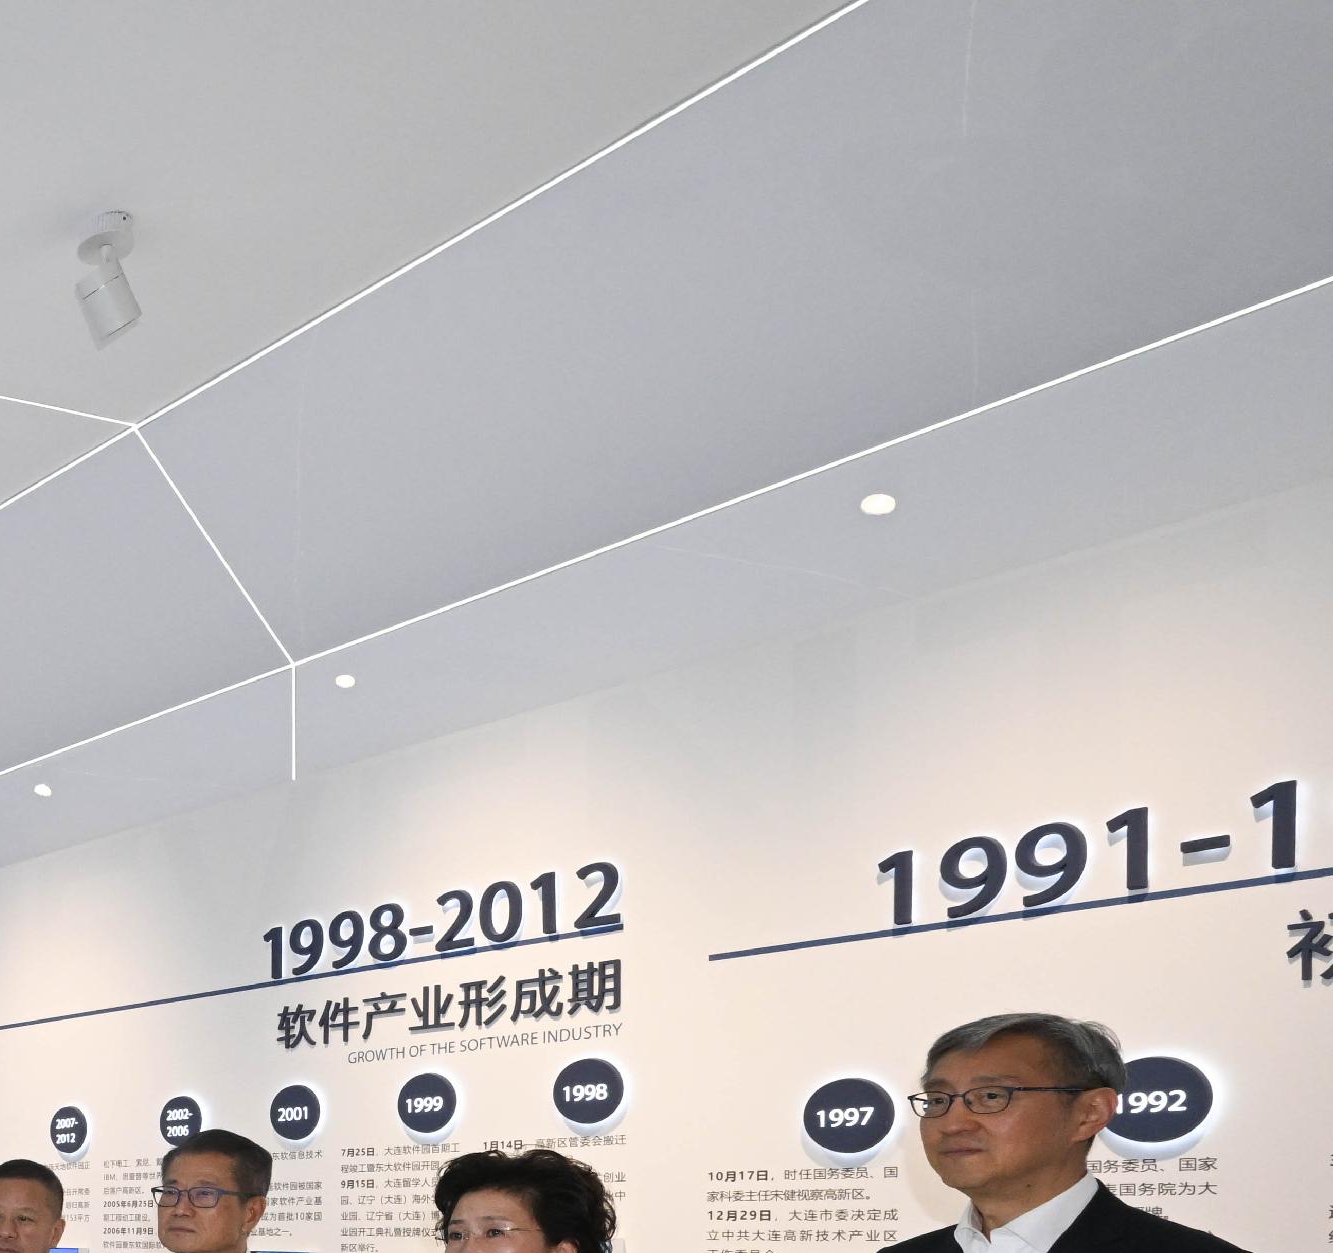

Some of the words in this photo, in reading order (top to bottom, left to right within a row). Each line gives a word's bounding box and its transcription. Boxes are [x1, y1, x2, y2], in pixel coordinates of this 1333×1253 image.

[263, 860, 622, 979] 1998-2012
[277, 958, 622, 1049] 软件产业形成期
[348, 1046, 406, 1065] GROWTH
[409, 1044, 426, 1058] OF
[430, 1040, 455, 1056] THE
[459, 1032, 538, 1053] SOFTWARE
[542, 1022, 623, 1045] INDUSTRY
[562, 1083, 608, 1102] 1998
[405, 1096, 444, 1114] 1999
[1116, 1089, 1187, 1114] 1992
[166, 1108, 193, 1122] 2002-
[278, 1106, 308, 1122] 2001
[816, 1106, 874, 1129] 1997
[55, 1117, 78, 1130] 2007-
[55, 1133, 75, 1145] 2012
[166, 1125, 189, 1138] 2006
[708, 1167, 899, 1182] 10月17日，时任国务委员、国
[707, 1189, 871, 1202] 家科委主任宋健视察高新区。
[708, 1209, 899, 1222] 12月29日，大连市委决定成
[706, 1229, 898, 1242] 立中共大连高新技术产业区
[340, 1243, 379, 1253] 新区举行。
